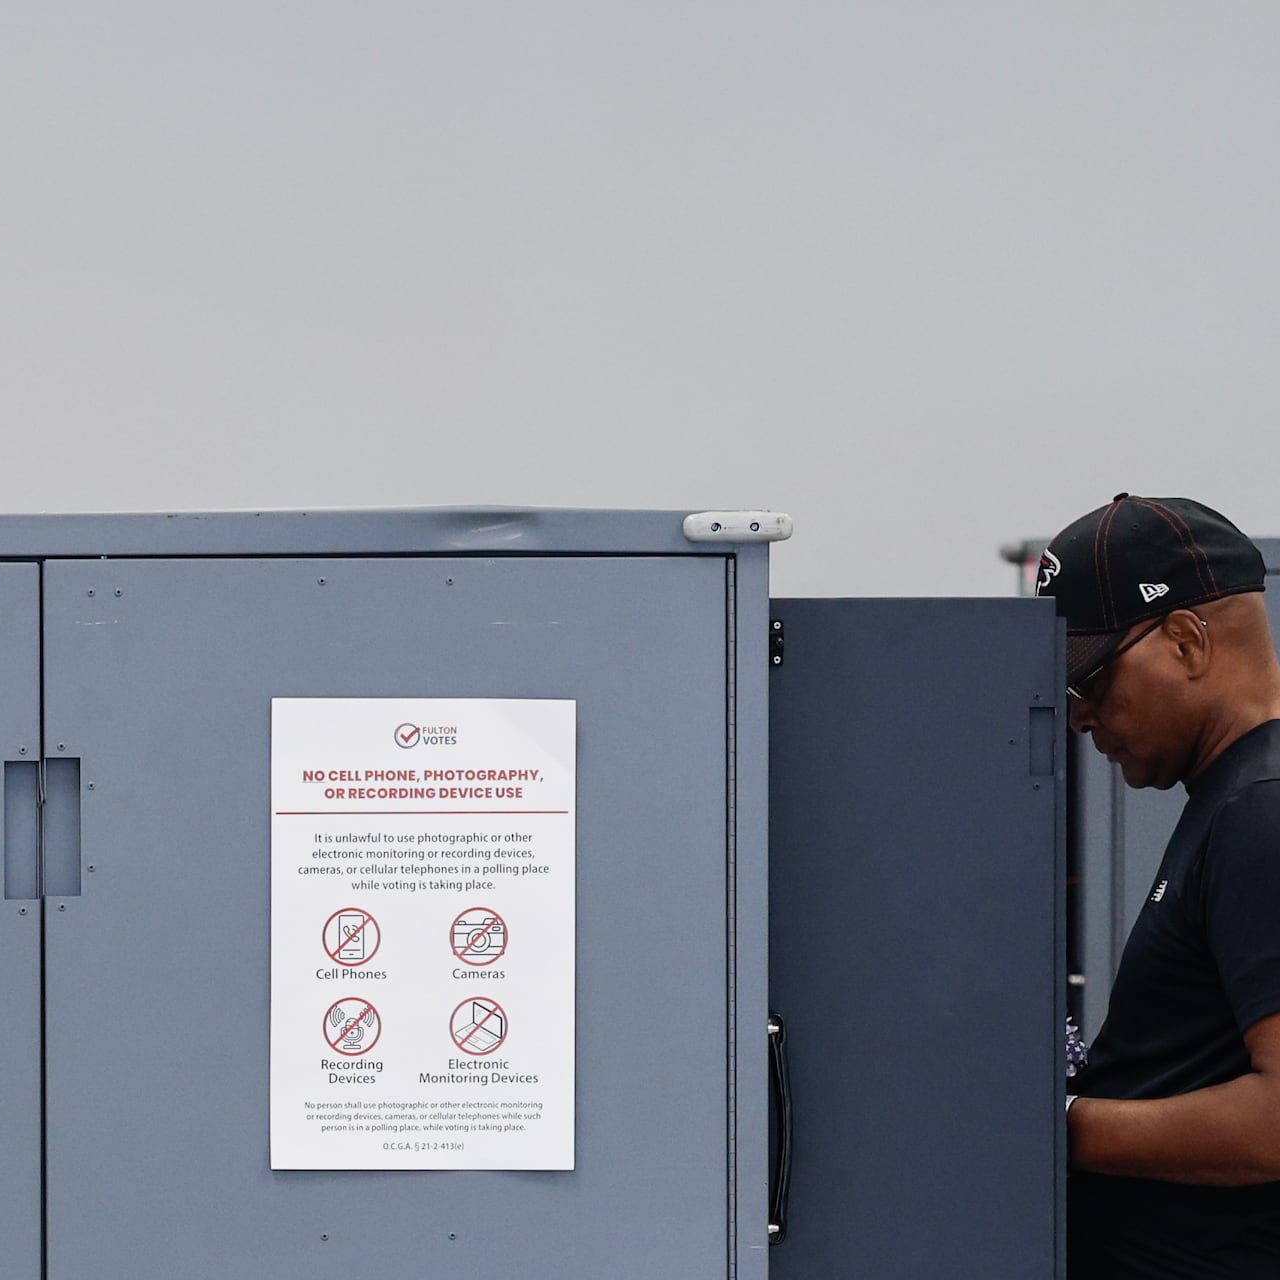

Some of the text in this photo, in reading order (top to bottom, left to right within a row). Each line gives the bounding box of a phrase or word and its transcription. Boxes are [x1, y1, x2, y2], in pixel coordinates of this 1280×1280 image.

[421, 726, 457, 735] FULTON
[422, 735, 457, 746] VOTES
[303, 770, 544, 783] NO CELL PHONE, PHOTOGRAPHY,
[324, 787, 523, 799] OR RECORDING DEVICE USE
[313, 831, 532, 846] It is unlawful to use photographic or other
[311, 847, 535, 862] electronic monitoring or recording devices,
[297, 863, 549, 877] cameras, or cellular telephones in a polling place
[350, 879, 495, 893] while voting is taking place.
[315, 967, 387, 980] Cell Phones
[451, 967, 505, 980] Cameras
[321, 1059, 383, 1072] Recording
[448, 1059, 509, 1069] Electronic
[328, 1073, 376, 1083] Devices
[419, 1073, 539, 1086] Monitoring Devices
[315, 1102, 343, 1111] person
[343, 1101, 362, 1110] shall
[377, 1100, 428, 1111] photographic
[439, 1100, 460, 1109] other
[460, 1100, 498, 1109] electronic
[499, 1101, 543, 1111] monitoring
[315, 1112, 352, 1123] recording
[352, 1112, 383, 1121] devices,
[384, 1113, 418, 1121] cameras,
[428, 1112, 456, 1121] cellular
[457, 1112, 500, 1122] telephones
[500, 1111, 522, 1120] while
[523, 1112, 541, 1120] such
[320, 1125, 347, 1134] person
[370, 1123, 398, 1134] polling
[398, 1123, 420, 1133] place,
[422, 1122, 443, 1132] while
[444, 1123, 469, 1133] voting
[477, 1123, 502, 1133] taking
[503, 1123, 525, 1133] place.
[381, 1141, 413, 1152] O.C.G.A.
[420, 1141, 465, 1153] 21-2-413(e)
